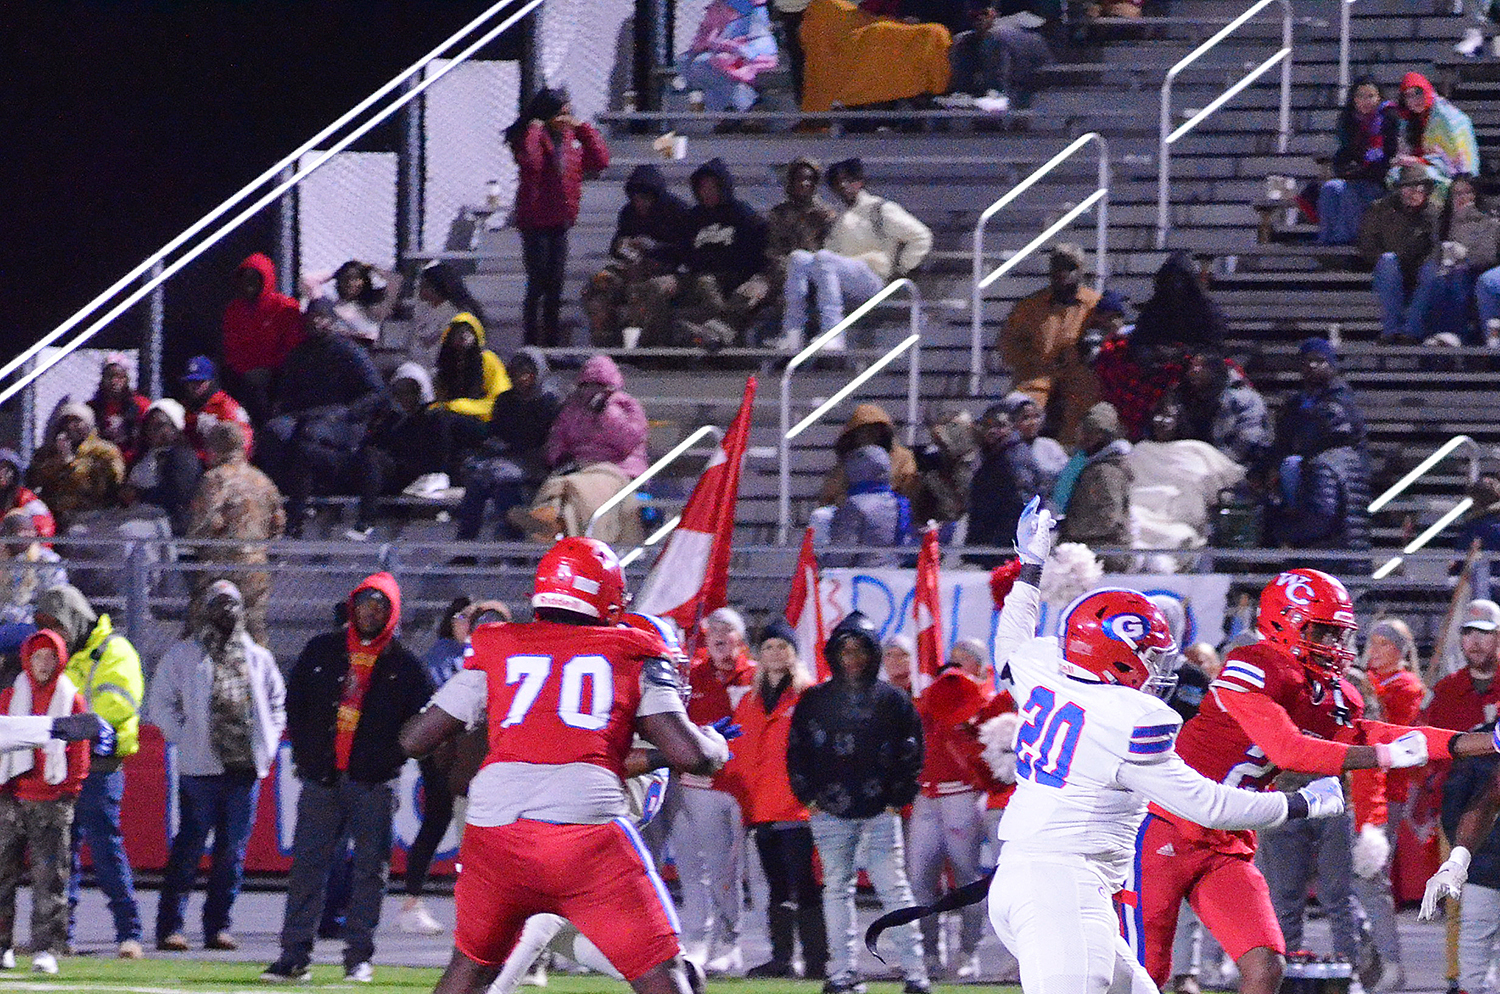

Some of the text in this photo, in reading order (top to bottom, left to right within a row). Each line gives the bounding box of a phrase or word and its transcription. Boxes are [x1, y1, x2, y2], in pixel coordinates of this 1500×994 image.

[1276, 572, 1315, 606] WC
[1112, 614, 1144, 637] G
[500, 653, 616, 731] 70
[1015, 685, 1086, 789] 20
